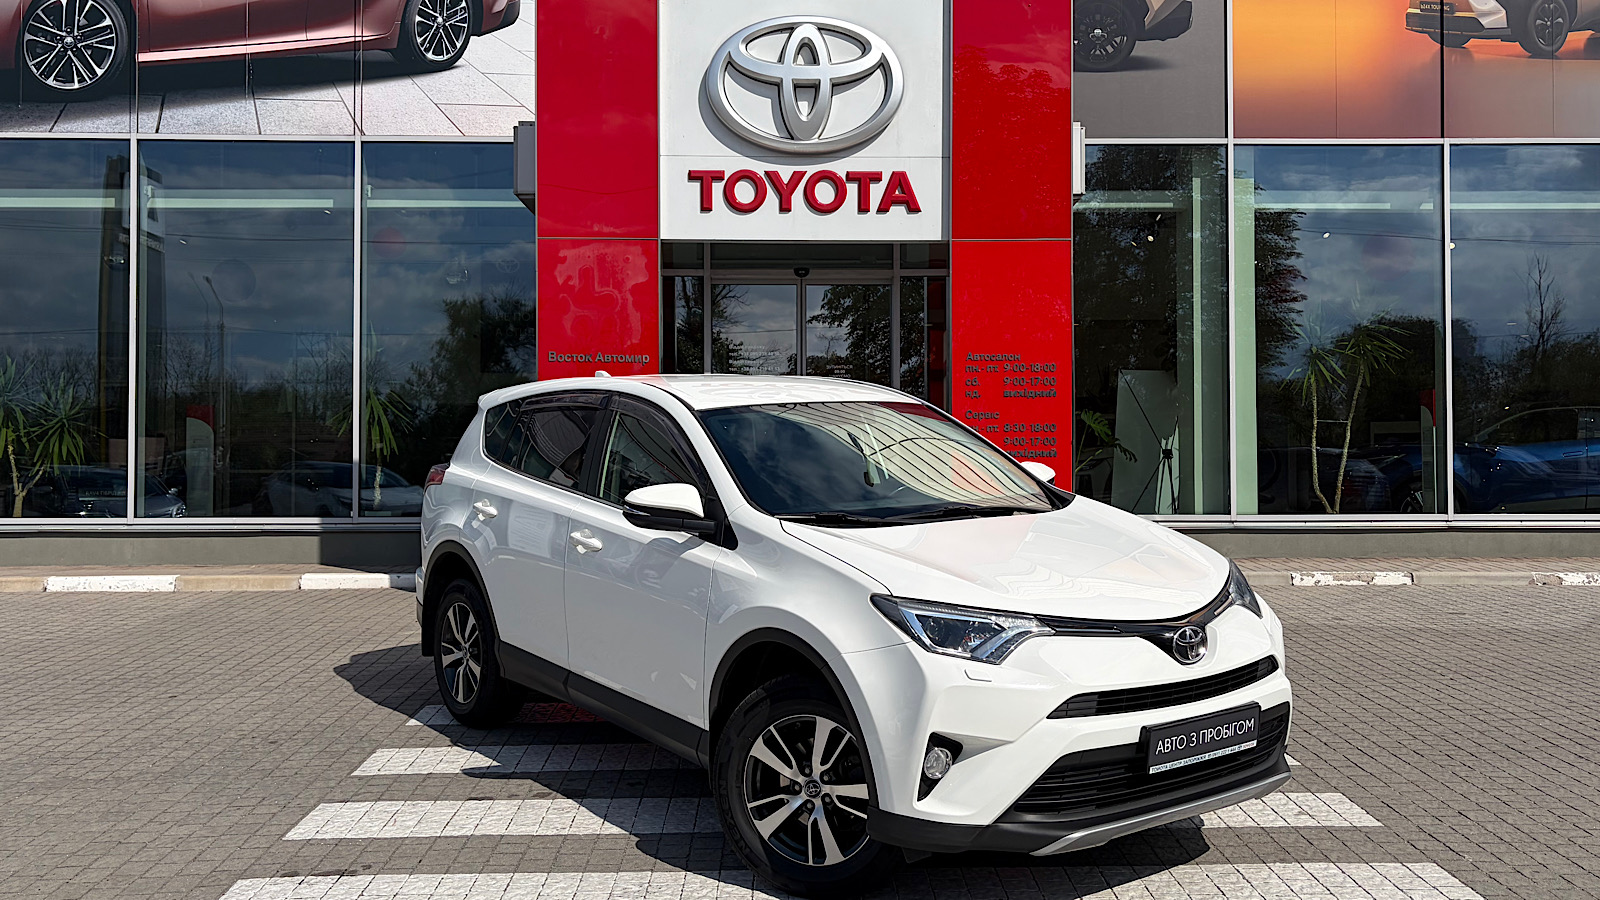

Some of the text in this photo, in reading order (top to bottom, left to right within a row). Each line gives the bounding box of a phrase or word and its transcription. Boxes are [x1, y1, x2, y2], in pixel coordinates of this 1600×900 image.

[687, 168, 922, 215] TOYOTA
[548, 351, 650, 366] Восток Автомир
[965, 352, 1021, 362] Автосалон
[1003, 363, 1057, 373] 9:00-18:00
[965, 376, 1057, 386] сб. 9:00-17:00
[965, 388, 1057, 399] нд. вихідний
[965, 410, 1000, 421] Сервіс
[1003, 423, 1057, 433] 8:30-18:00
[1003, 437, 1057, 447] 9:00-17:00
[1155, 717, 1255, 755] АВТО З ПРОБІГОМ
